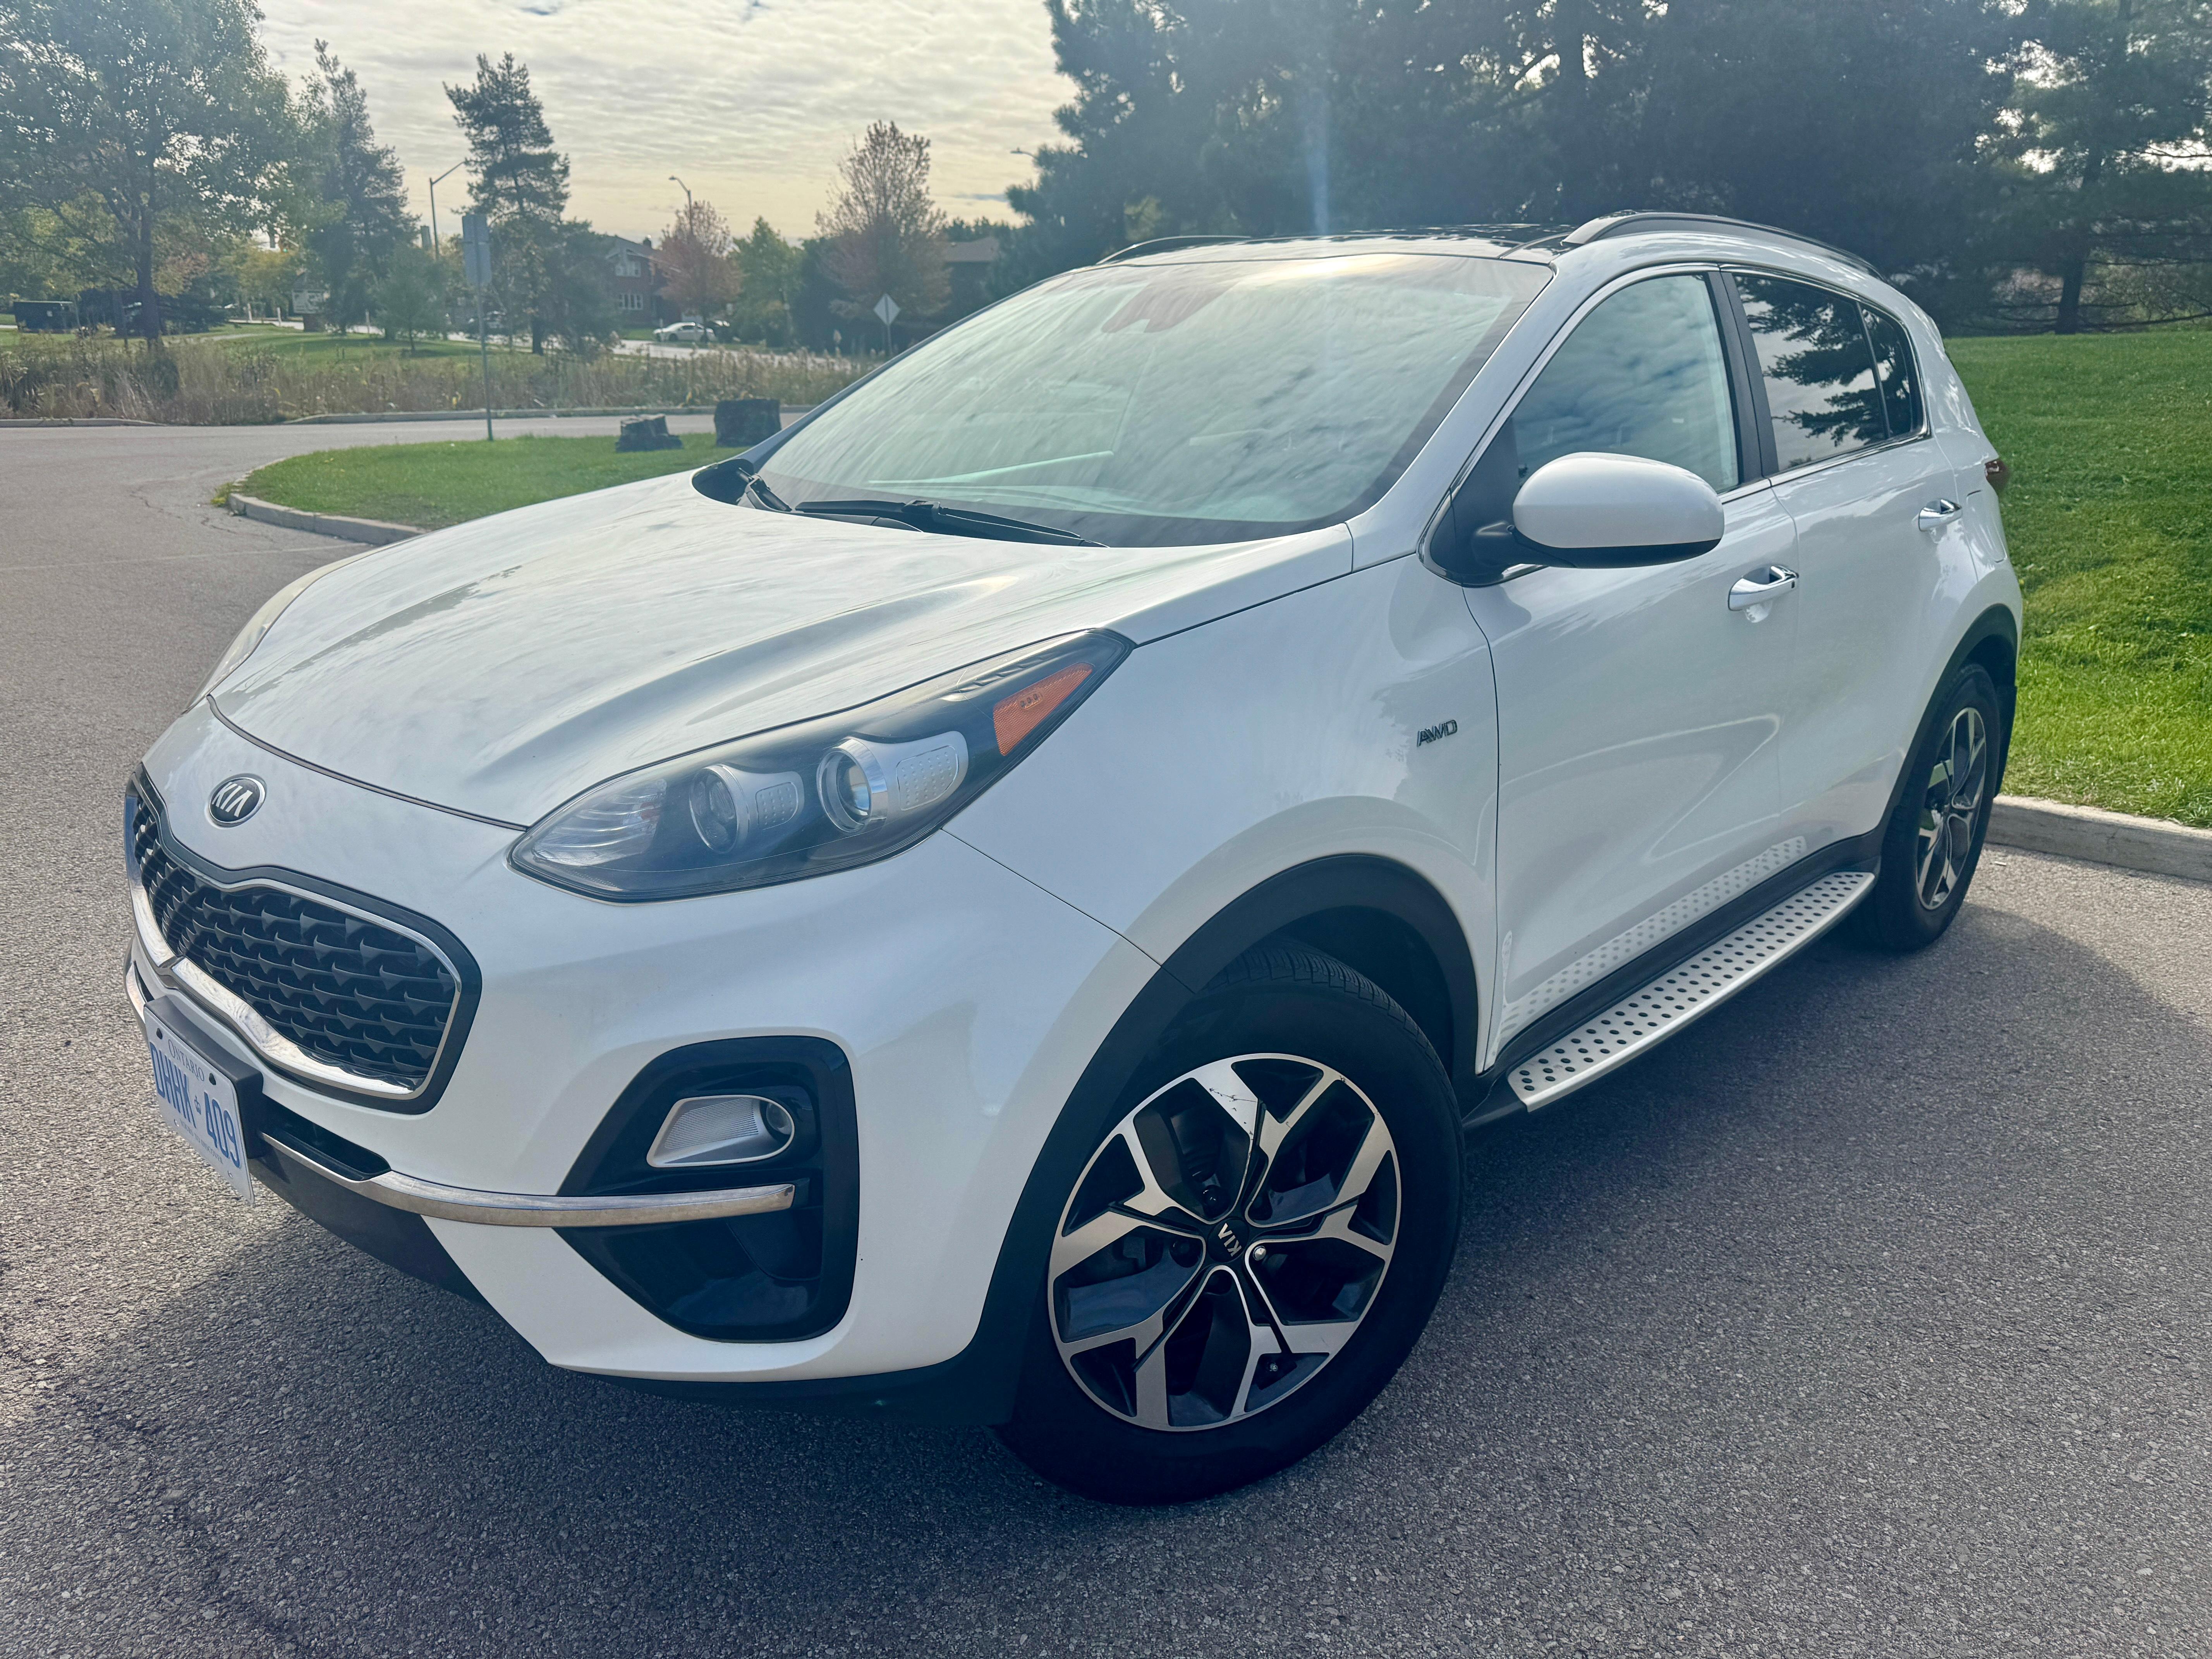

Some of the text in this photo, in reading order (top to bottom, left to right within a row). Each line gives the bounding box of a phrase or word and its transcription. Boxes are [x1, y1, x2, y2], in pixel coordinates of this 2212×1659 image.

[1417, 720, 1458, 747] AWD
[212, 781, 253, 817] KIA
[168, 1039, 204, 1082] ONTARIO
[149, 1041, 240, 1168] DHHK 409
[1218, 1223, 1242, 1257] KIA
